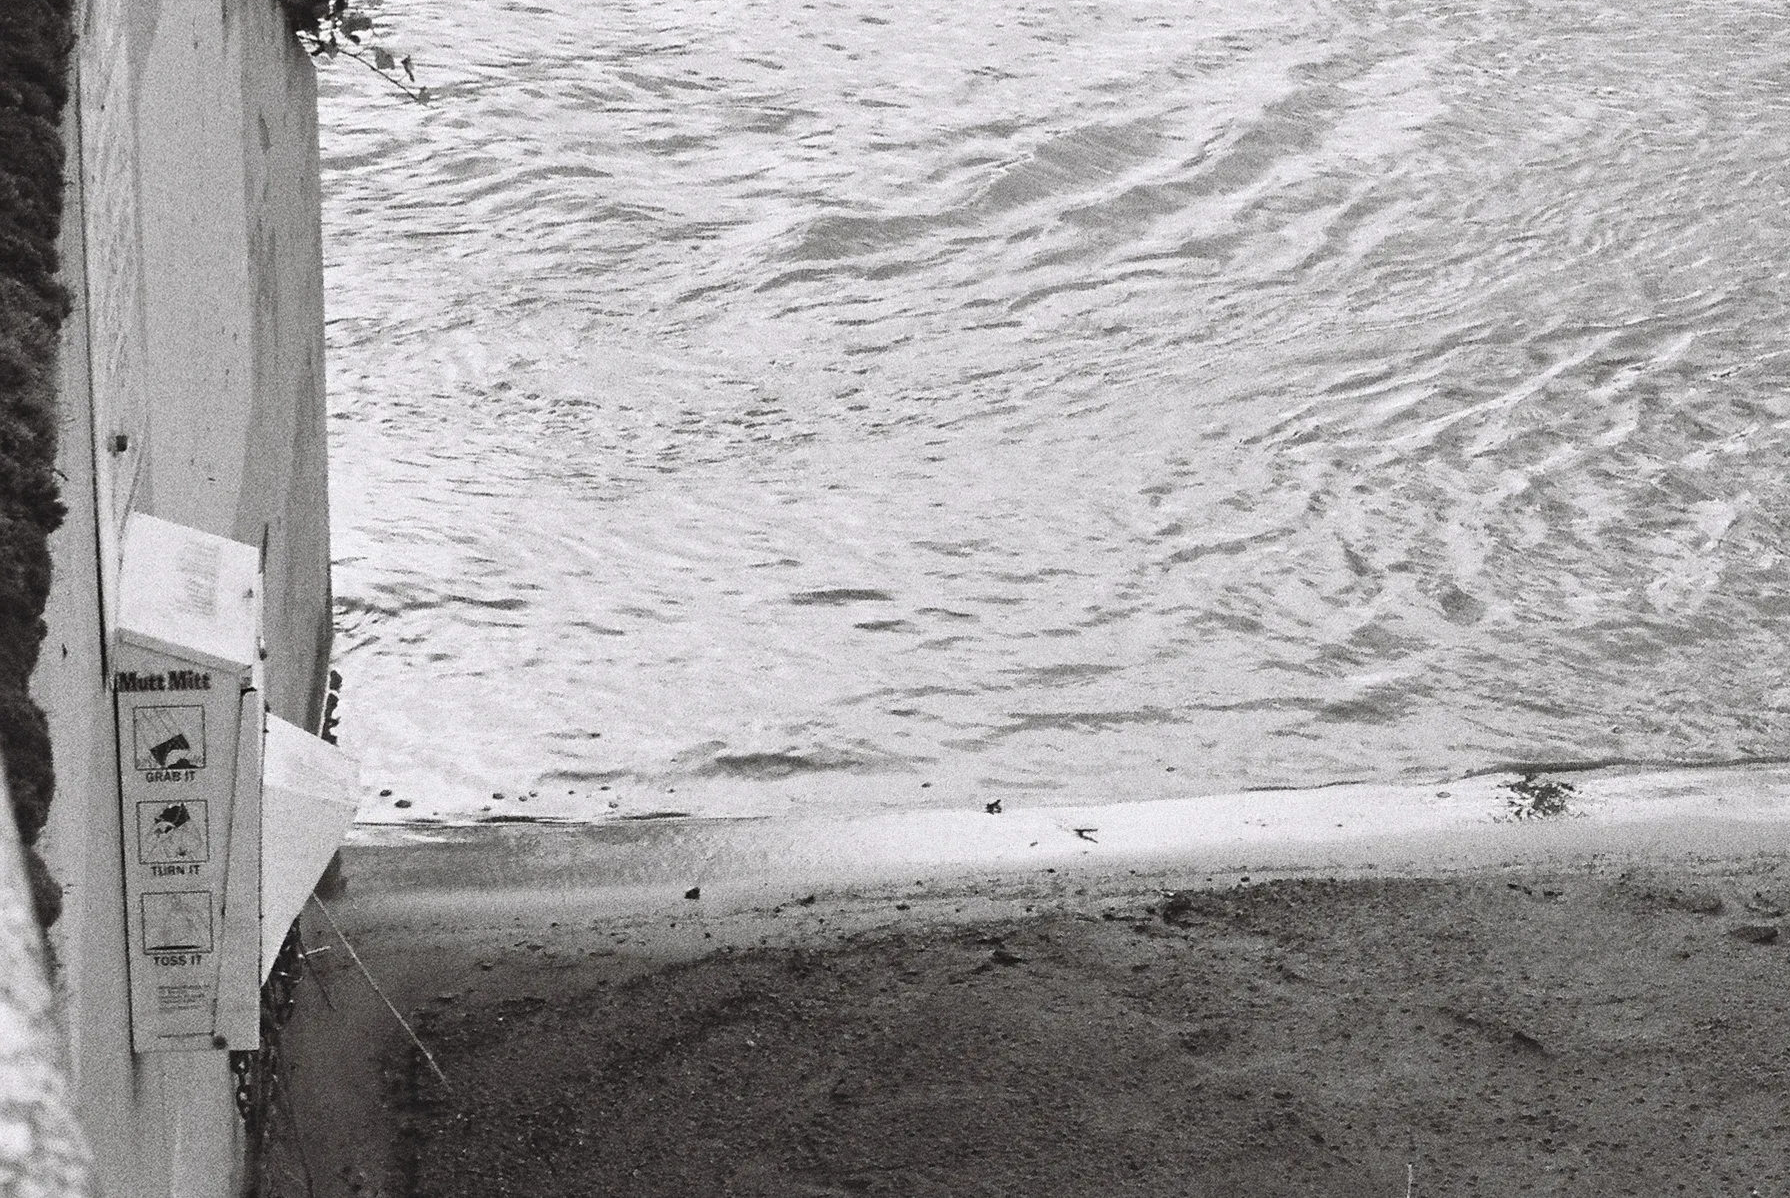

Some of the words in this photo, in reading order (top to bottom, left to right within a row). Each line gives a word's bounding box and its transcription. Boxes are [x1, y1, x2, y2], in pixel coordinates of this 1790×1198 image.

[116, 671, 165, 692] Mutt
[167, 670, 211, 691] Mitt
[145, 770, 182, 783] GRAB
[184, 769, 197, 782] IT
[151, 865, 186, 877] TURN
[188, 864, 201, 876] IT
[154, 955, 188, 967] TOSS
[190, 954, 203, 966] IT
